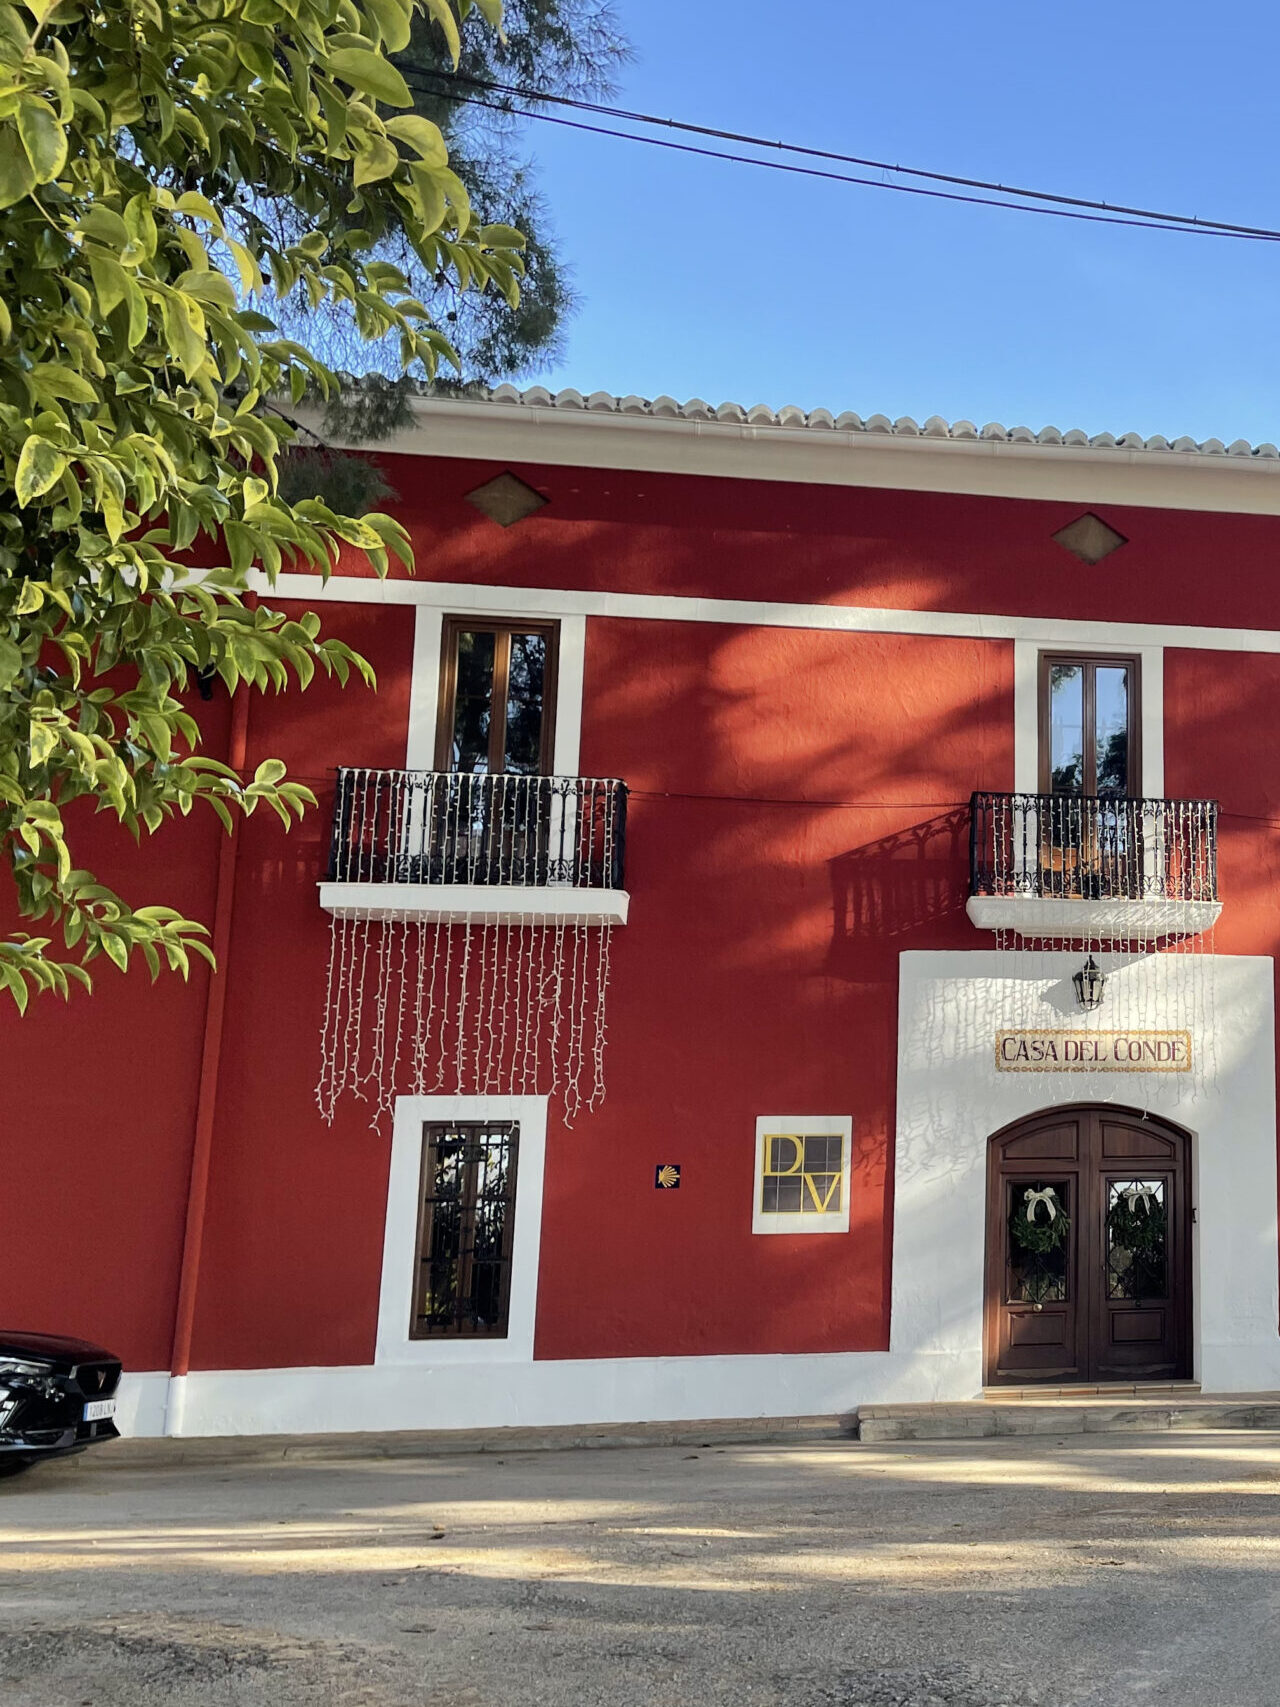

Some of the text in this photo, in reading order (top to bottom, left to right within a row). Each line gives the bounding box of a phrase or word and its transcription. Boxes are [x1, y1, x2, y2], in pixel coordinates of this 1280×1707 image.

[1002, 1037, 1186, 1062] CASA DEL CONDE
